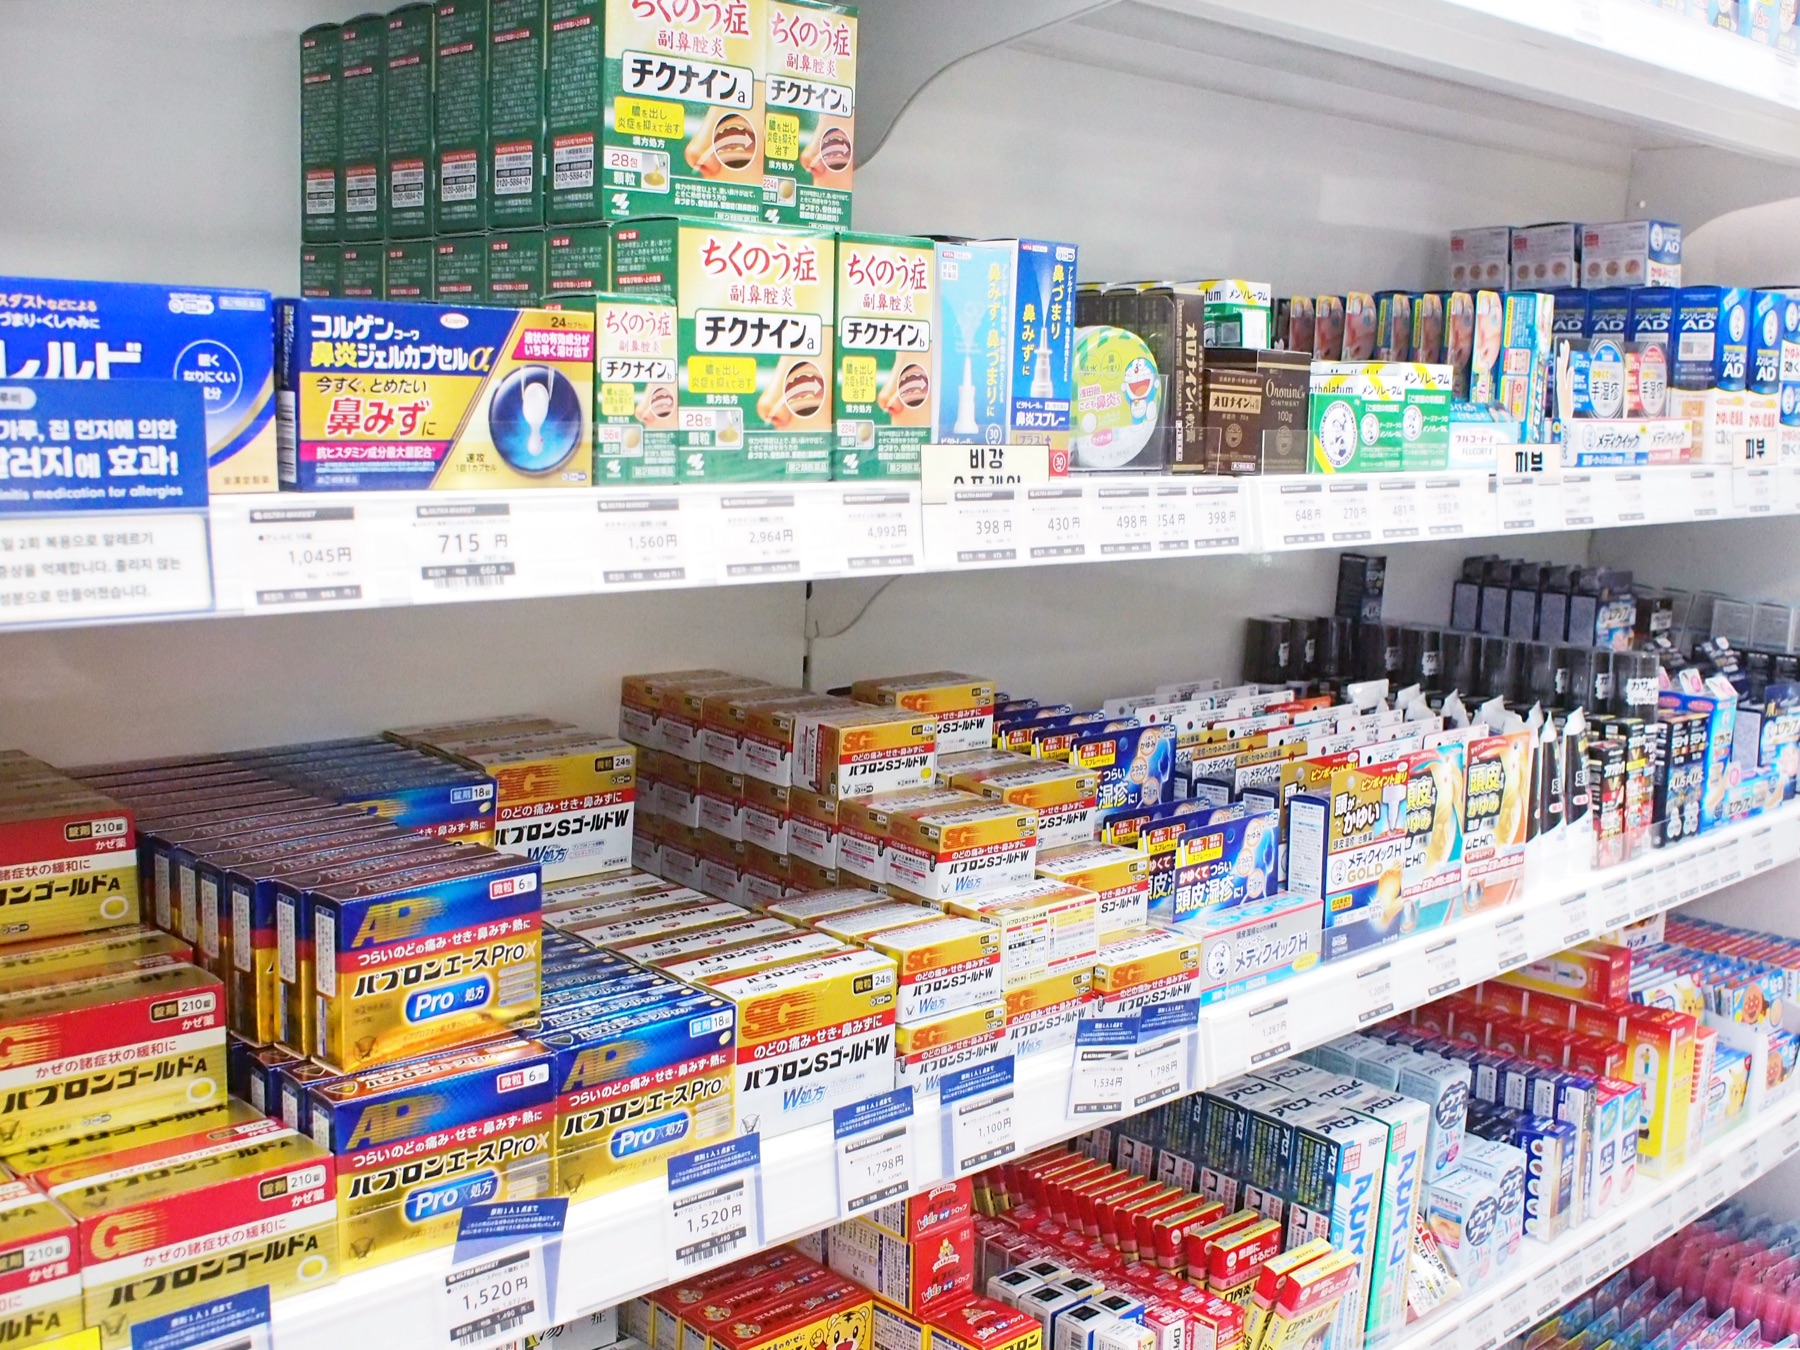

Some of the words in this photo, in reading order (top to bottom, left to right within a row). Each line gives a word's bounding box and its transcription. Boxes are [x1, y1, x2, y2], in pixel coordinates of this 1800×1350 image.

[657, 29, 726, 59] 副鼻腔炎
[771, 12, 851, 57] ちくのう症
[631, 58, 746, 103] チクナインa
[771, 79, 848, 113] チクナインb
[617, 117, 682, 136] 炎症を抑えて治す
[632, 136, 665, 149] 漢方処方
[774, 145, 790, 157] 治す
[613, 171, 636, 187] 顆粒
[702, 238, 818, 282] ちくのう症
[848, 253, 927, 291] ちくのう症
[729, 284, 793, 307] 副鼻腔炎
[862, 293, 914, 313] 副鼻腔炎
[1051, 264, 1065, 340] 鼻づまり
[1228, 289, 1268, 302] メンソレータム
[311, 314, 420, 341] コルゲンコーワ
[704, 316, 814, 350] チクナインa
[1636, 320, 1669, 331] AD
[1682, 319, 1716, 330] AD
[848, 322, 925, 348] チクナインb
[1021, 303, 1036, 376] 鼻みずに
[606, 361, 672, 380] チクナインb
[1405, 371, 1451, 387] メンソレータム
[1723, 363, 1744, 378] AD
[1756, 366, 1777, 381] AD
[316, 376, 427, 394] 今すぐ、とめたい
[1362, 386, 1402, 398] メンソレータム
[706, 394, 738, 405] 漢方処方
[327, 398, 437, 437] 鼻みずに
[686, 413, 713, 427] 28包
[1015, 411, 1066, 427] 鼻炎スプレー
[688, 432, 710, 446] 顆粒
[107, 445, 179, 477] 효과!
[970, 448, 1004, 469] 비강
[129, 484, 183, 499] allergies
[1048, 516, 1080, 532] 430円
[1117, 514, 1148, 530] 498円
[1295, 508, 1321, 522] 648円
[749, 529, 793, 545] 2,964円
[866, 524, 907, 538] 4,992円
[976, 519, 1012, 536] 398円
[438, 534, 480, 553] 715
[628, 534, 678, 550] 1,560円
[289, 546, 352, 567] 1,045円
[1468, 763, 1501, 795] 頭皮
[501, 791, 623, 820] のどの痛み・せき・鼻みずに
[1467, 796, 1499, 818] かゆみ
[496, 808, 630, 846] パブロンSゴールドW
[1342, 803, 1380, 835] かゆい
[95, 837, 127, 851] かぜ薬
[1348, 843, 1402, 869] メディクイックH
[1179, 866, 1209, 885] かゆくて
[1210, 861, 1232, 877] つらい
[1347, 865, 1383, 883] GOLD
[493, 880, 514, 896] 微粒
[1175, 875, 1244, 915] 頭皮湿疹に!
[1101, 894, 1141, 913] SゴールドW
[358, 918, 531, 967] つらいのどの痛み・せき・鼻みず・熱に
[1234, 931, 1308, 974] メディクイックH
[915, 957, 990, 981] のどの痛み・せき・鼻みずに
[855, 977, 873, 993] 微粒
[875, 973, 892, 987] 24包
[913, 967, 994, 997] パブロンSゴールドW
[181, 998, 212, 1012] 210錠
[182, 1014, 215, 1031] かぜ薬
[754, 1014, 883, 1060] のどの痛み・せき・鼻みずに
[36, 1040, 177, 1079] かぜの諸症状の緩和に
[744, 1034, 890, 1093] パブロンSゴールドW
[1149, 1060, 1178, 1079] 1,798円
[1, 1054, 209, 1115] パブロンゴールドA
[501, 1072, 523, 1089] 微粒
[569, 1053, 727, 1107] つらいのどの痛み・せき・鼻みず・熱に
[1093, 1076, 1123, 1088] 1,534円
[783, 1084, 828, 1112] W処方
[1225, 1083, 1271, 1101] アセス
[1269, 1098, 1318, 1117] アセス
[977, 1117, 1012, 1138] 1,100円
[1316, 1115, 1364, 1134] アセス
[353, 1110, 543, 1167] つらいのどの痛み・せき・鼻みず・熱に
[866, 1155, 904, 1177] 1,798円
[290, 1172, 321, 1188] 210錠
[686, 1204, 742, 1233] 1,520円
[917, 1212, 938, 1232] kids
[951, 1204, 968, 1215] シロップ
[29, 1244, 63, 1262] 210錠
[143, 1218, 287, 1268] かぜの諸症状の緩和に
[1250, 1246, 1278, 1265] 貼るだけ
[108, 1233, 319, 1308] パブロンゴールドA
[463, 1276, 528, 1311] 1,520円
[921, 1283, 942, 1303] kids
[954, 1273, 970, 1285] シロップ
